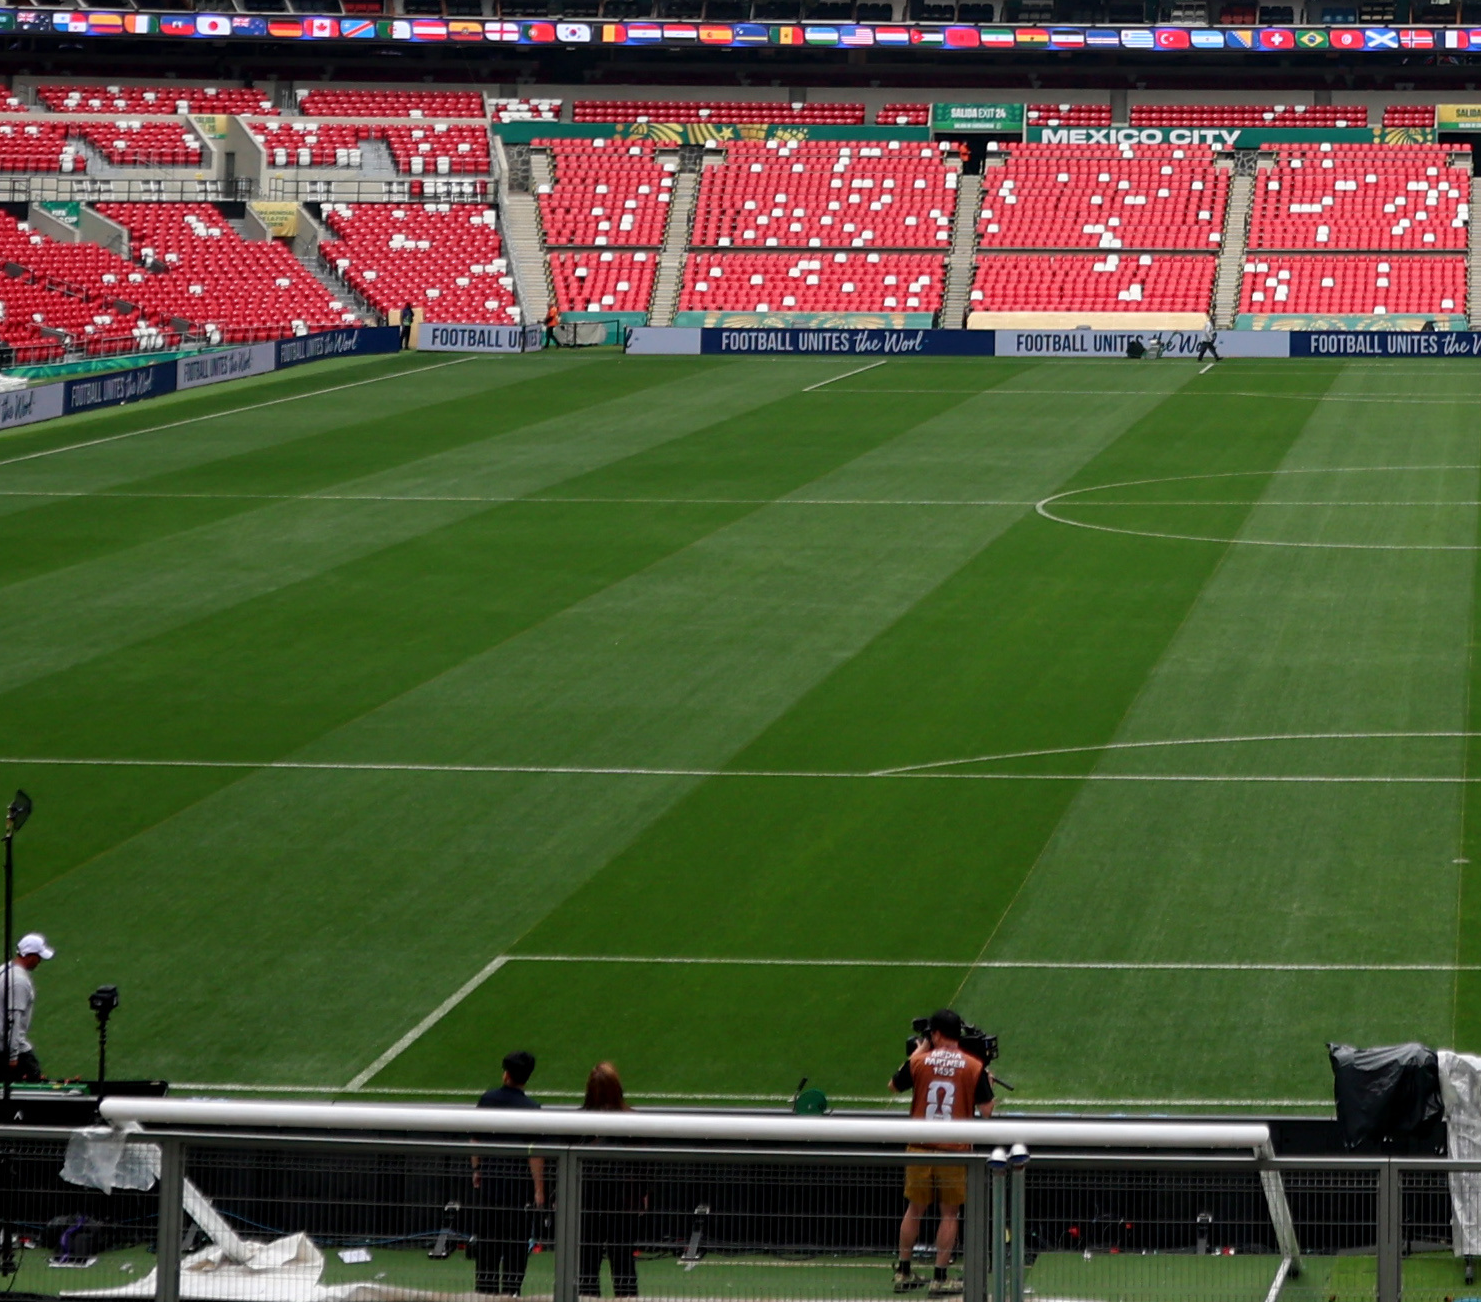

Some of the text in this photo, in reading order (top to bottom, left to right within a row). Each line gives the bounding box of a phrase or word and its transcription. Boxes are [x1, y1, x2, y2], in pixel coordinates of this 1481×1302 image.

[951, 108, 1006, 118] SALIDA EXIT 24
[1456, 109, 1481, 118] SALIDA
[1041, 129, 1241, 145] MEXICO CITY
[432, 328, 502, 349] FOOTBALL
[722, 332, 793, 351] FOOTBALL
[799, 332, 849, 351] UNITES
[853, 331, 881, 352] the
[1017, 334, 1087, 352] FOOTBALL
[1311, 335, 1382, 353] FOOTBALL
[1388, 335, 1437, 353] UNITES
[1442, 333, 1470, 354] the
[71, 381, 101, 407] FOOTBALL
[924, 1056, 966, 1069] PARTNER
[931, 1050, 962, 1059] MEDIA
